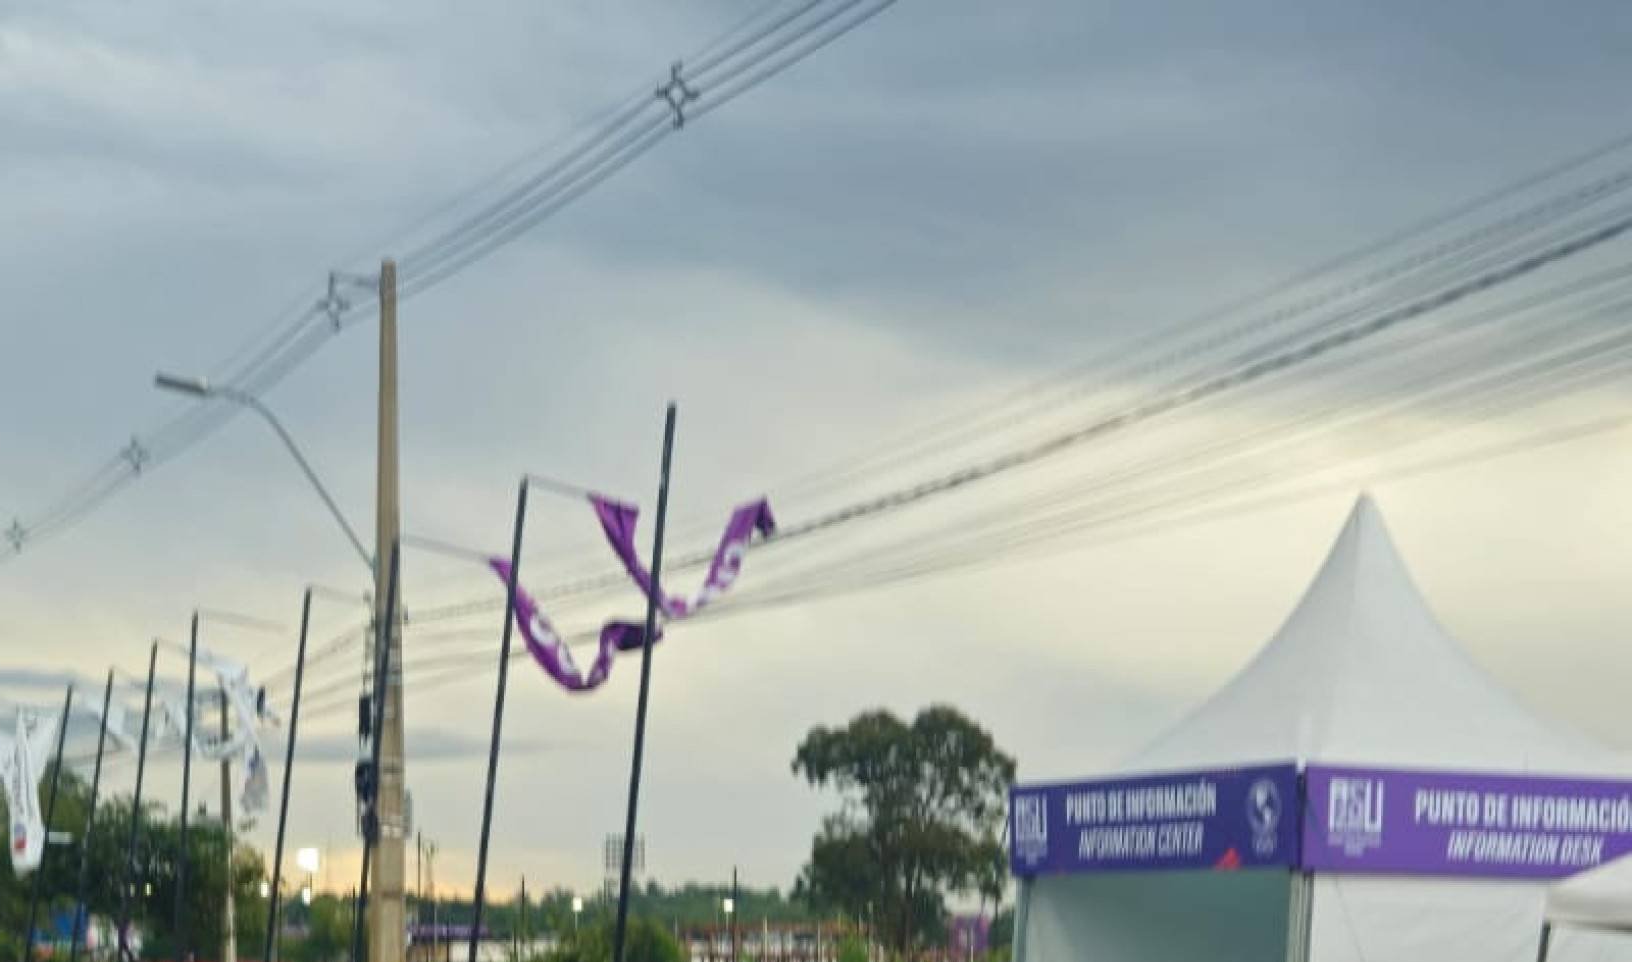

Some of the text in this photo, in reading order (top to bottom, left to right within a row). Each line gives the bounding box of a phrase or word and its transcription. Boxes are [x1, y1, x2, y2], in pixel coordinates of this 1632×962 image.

[1067, 779, 1216, 825] PUNTO DE INFORMACIÓN
[1415, 788, 1632, 832] PUNTO DE INFORMACIÓ
[1078, 824, 1157, 861] INFORMATION
[1157, 820, 1204, 858] CENTER
[1448, 829, 1605, 866] INFORMATION DESK
